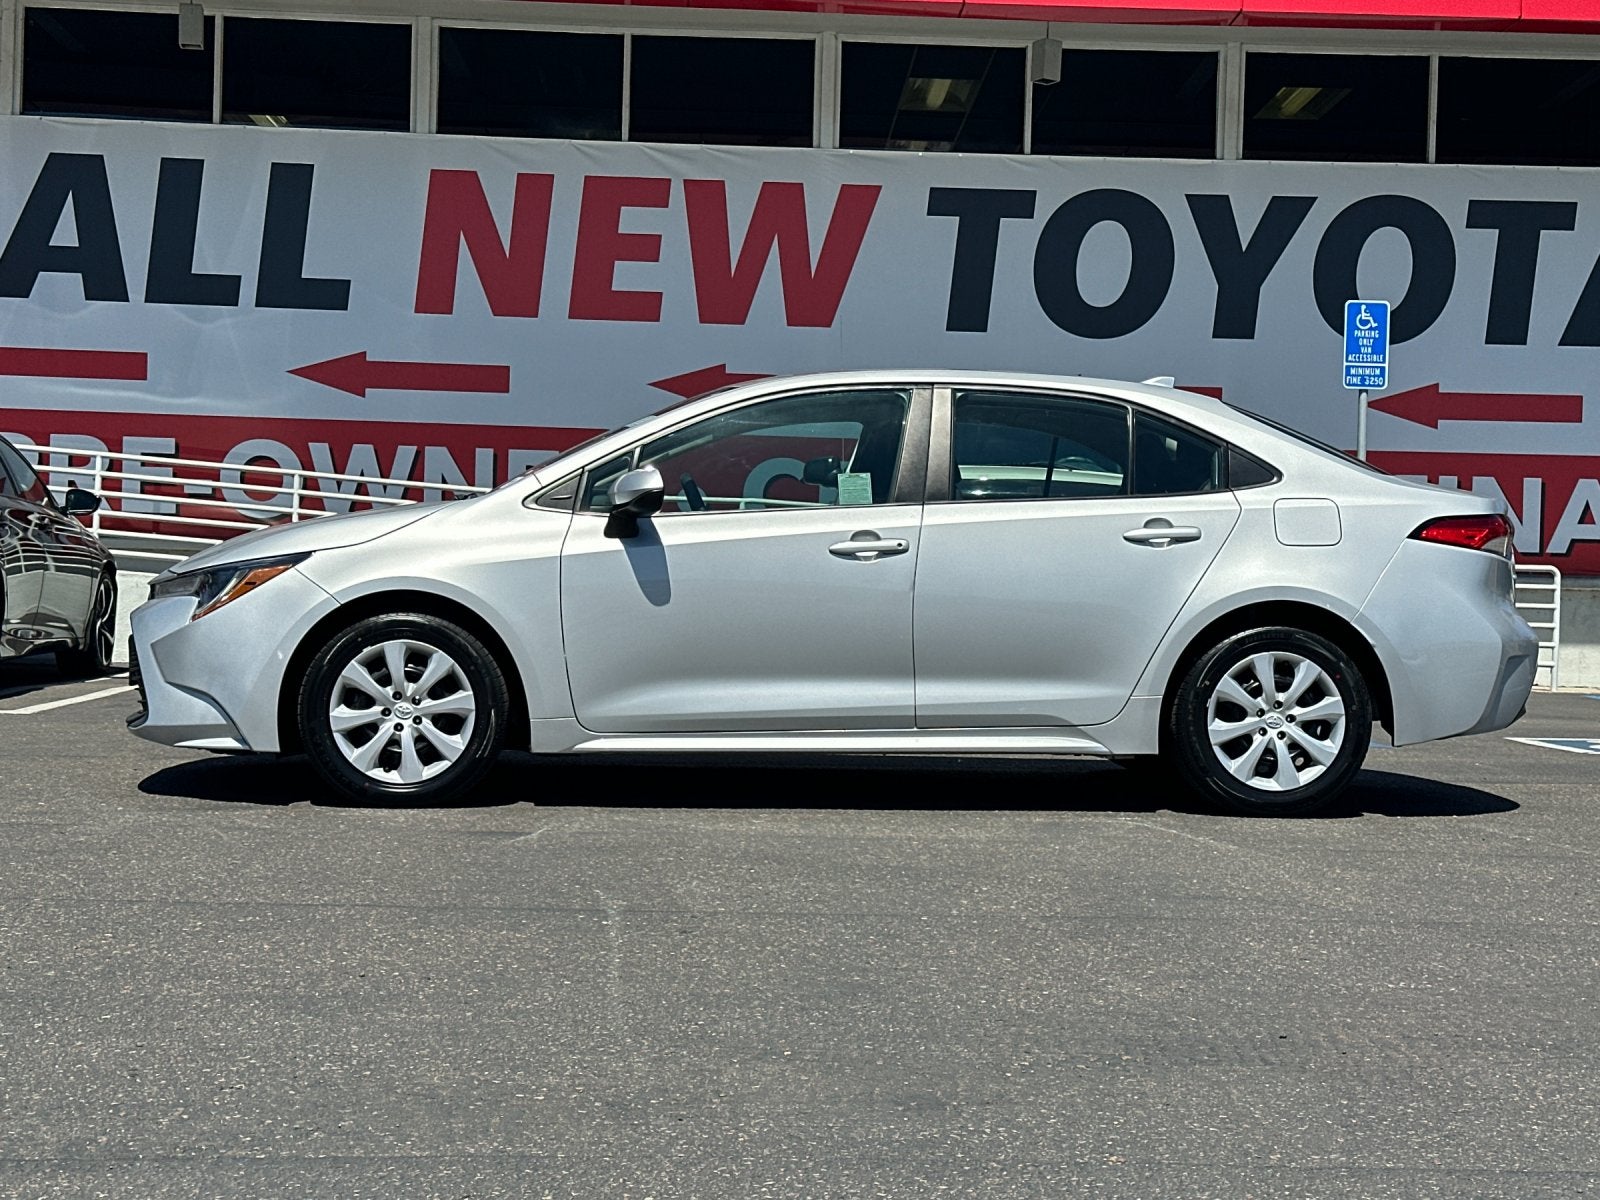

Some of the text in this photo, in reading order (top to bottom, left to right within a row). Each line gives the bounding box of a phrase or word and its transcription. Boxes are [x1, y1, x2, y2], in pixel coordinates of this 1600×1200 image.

[0, 152, 352, 311] ALL
[414, 168, 882, 328] NEW
[1354, 330, 1379, 338] PARKING
[1358, 338, 1374, 346] ONLY
[1360, 346, 1372, 354] VAN
[1348, 354, 1383, 362] ACCESSIBLE
[1350, 367, 1380, 375] MINIMUM
[1346, 376, 1362, 384] FINE
